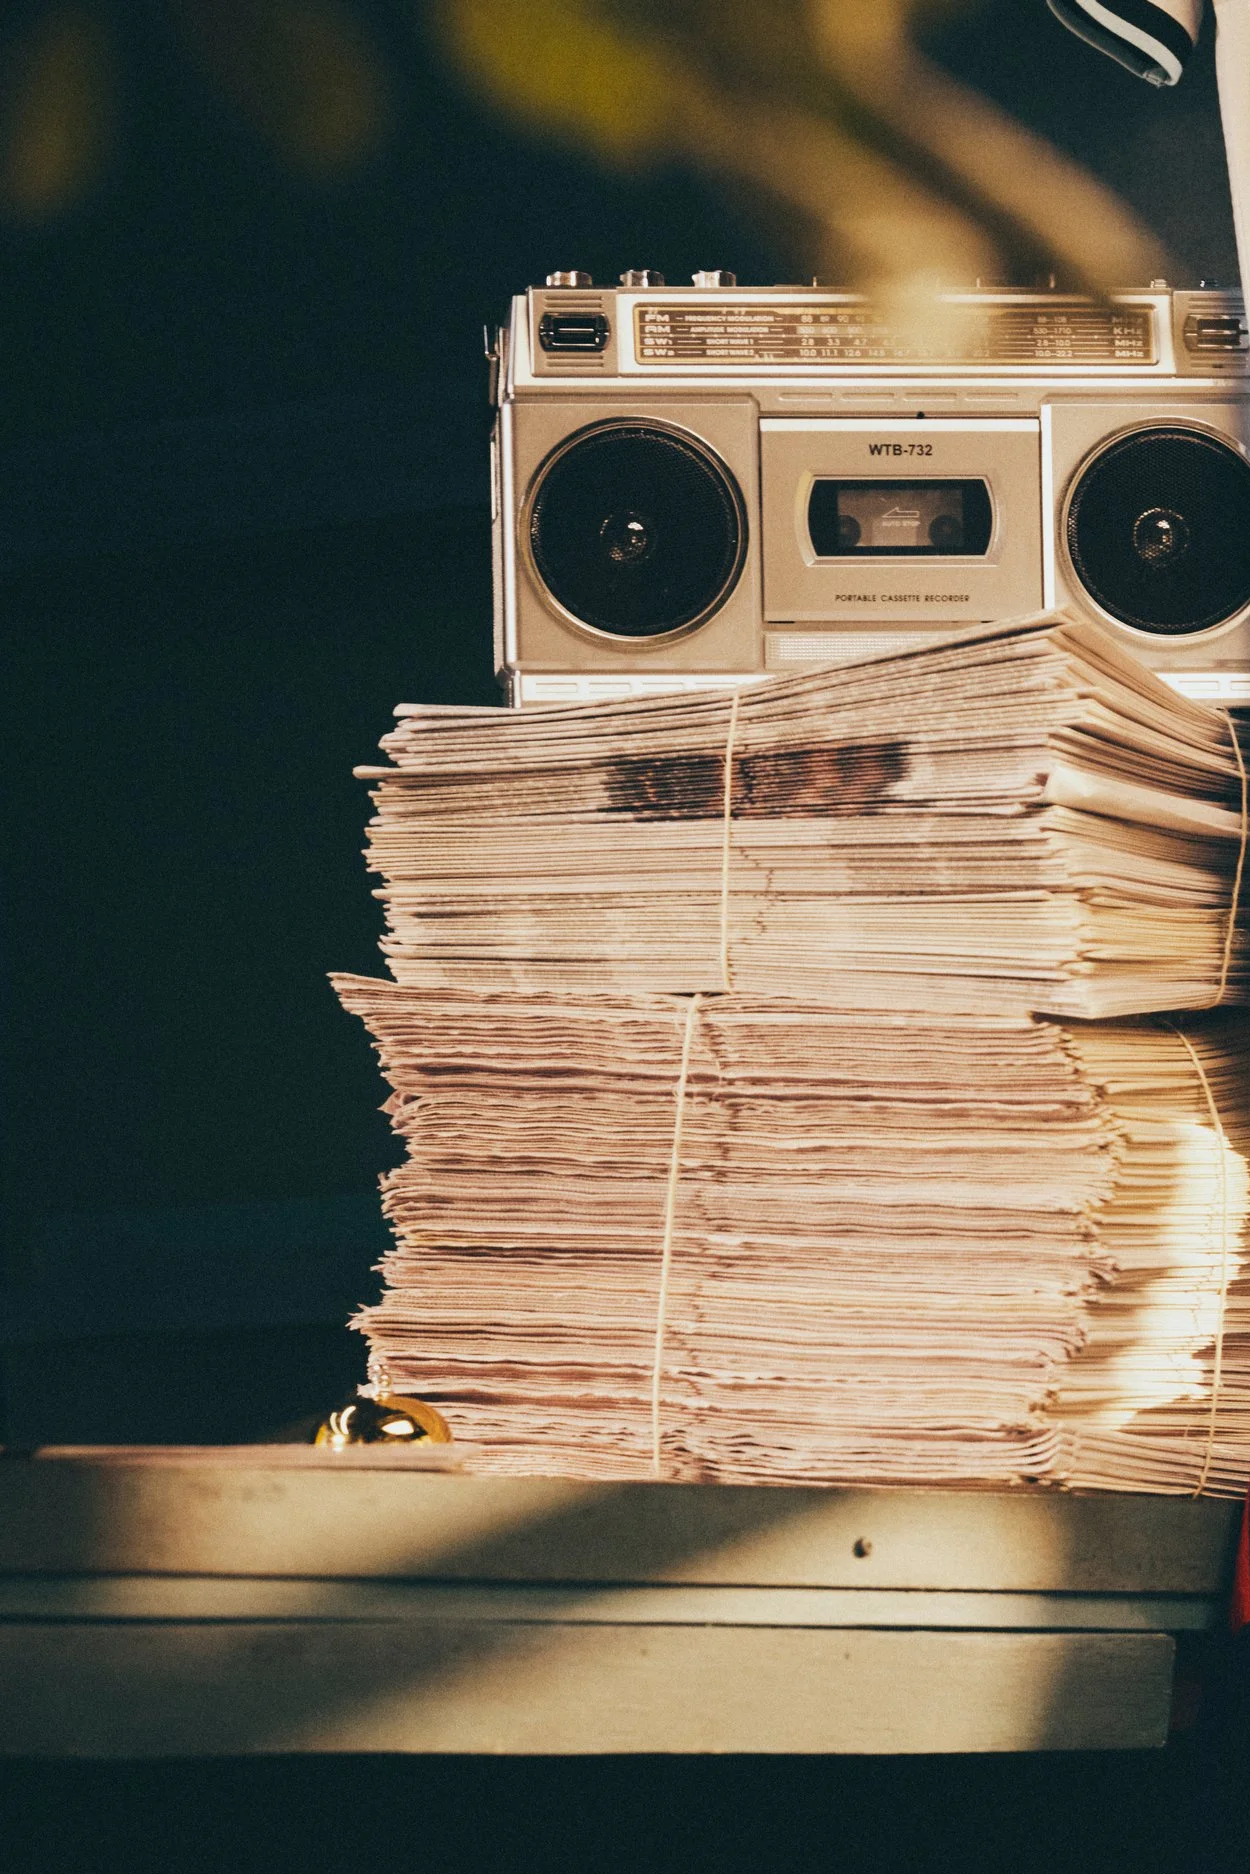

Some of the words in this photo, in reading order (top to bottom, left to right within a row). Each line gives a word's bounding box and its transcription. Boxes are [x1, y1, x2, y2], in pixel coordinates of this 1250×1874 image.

[644, 314, 670, 322] FM
[644, 325, 671, 333] AM
[801, 338, 815, 346] 2.8
[827, 338, 841, 346] 3.3
[1114, 339, 1144, 347] MHz
[1114, 349, 1144, 358] MHz
[868, 444, 933, 457] WTB-732
[835, 594, 877, 603] PORTABLE
[880, 594, 921, 603] CASSETTE
[924, 594, 970, 603] RECORDER
